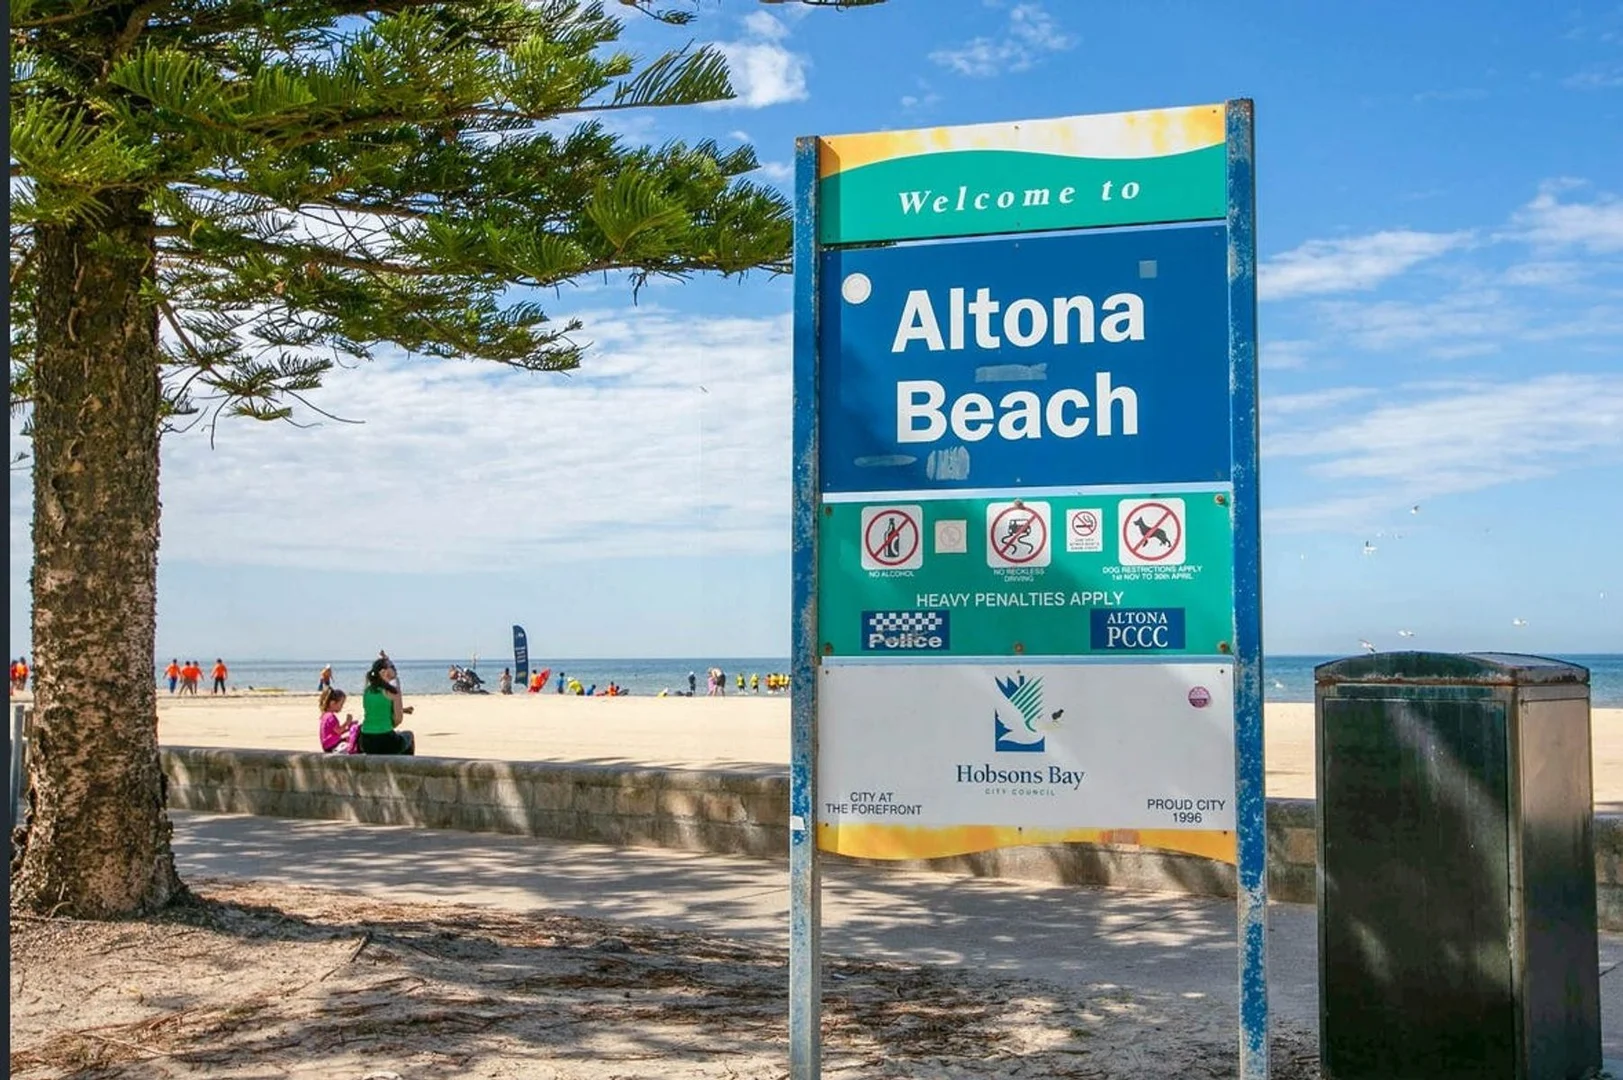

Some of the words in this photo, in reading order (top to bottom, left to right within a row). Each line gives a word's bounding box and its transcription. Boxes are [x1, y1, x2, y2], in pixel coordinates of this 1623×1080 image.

[898, 186, 1076, 215] Welcome
[1102, 180, 1140, 201] to
[892, 287, 1145, 353] Altona
[896, 371, 1139, 443] Beach
[916, 593, 970, 608] HEAVY
[975, 591, 1065, 607] PENALTIES
[1070, 591, 1124, 606] APPLY
[1107, 611, 1168, 624] ALTONA
[869, 632, 943, 648] Police
[1106, 626, 1169, 648] PCCC
[956, 763, 1043, 784] Hobsons
[1048, 766, 1086, 790] Bay
[850, 792, 876, 803] CITY
[878, 792, 893, 803] AT
[985, 788, 1007, 796] CITY
[1012, 788, 1056, 797] COUNCIL
[826, 803, 849, 814] THE
[851, 804, 923, 815] FOREFRONT
[1147, 798, 1193, 810] PROUD
[1196, 799, 1226, 811] CITY
[1173, 812, 1203, 823] 1996
